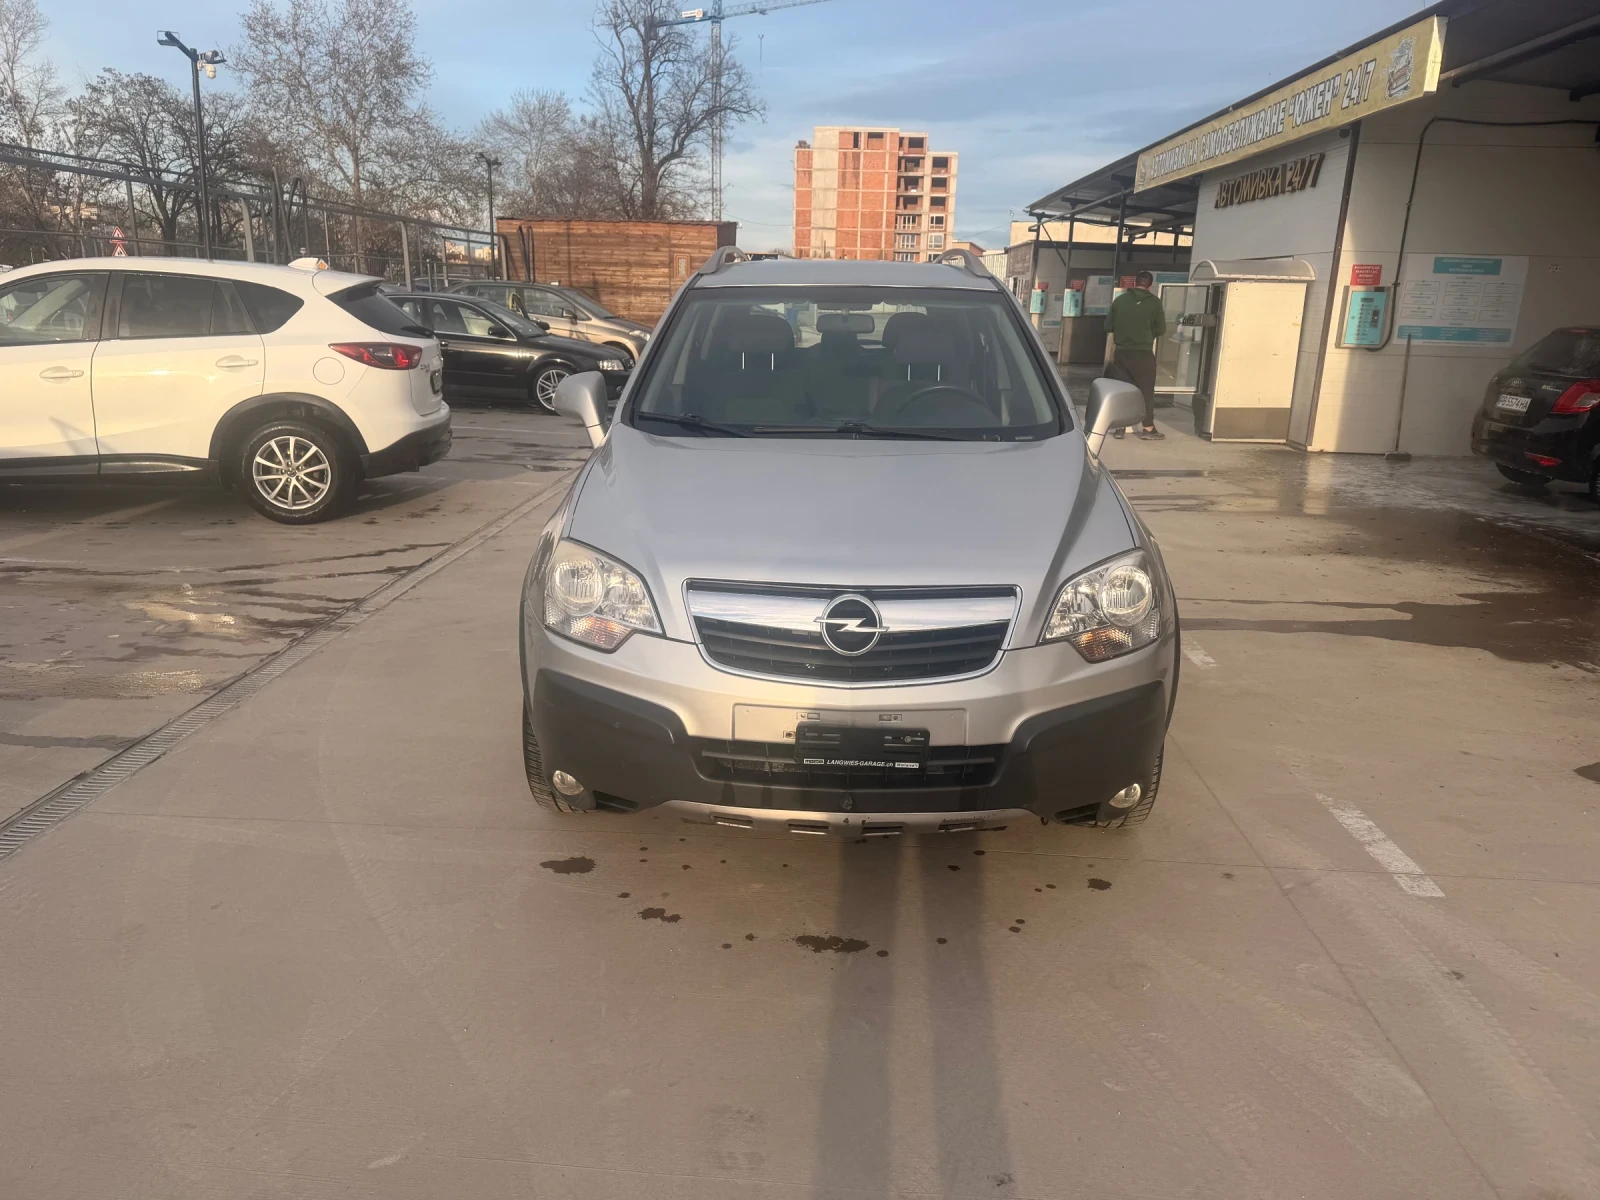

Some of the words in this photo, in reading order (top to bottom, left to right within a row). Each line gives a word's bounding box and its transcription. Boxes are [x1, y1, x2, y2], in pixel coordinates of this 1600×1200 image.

[1150, 142, 1188, 180] АВТОМИВКА
[1187, 137, 1199, 166] НА
[1199, 99, 1287, 162] САМООБСЛУЖВАНЕ
[1341, 58, 1377, 110] 24/7
[1214, 163, 1286, 209] АВТОМИВКА
[1284, 152, 1325, 194] 24/7
